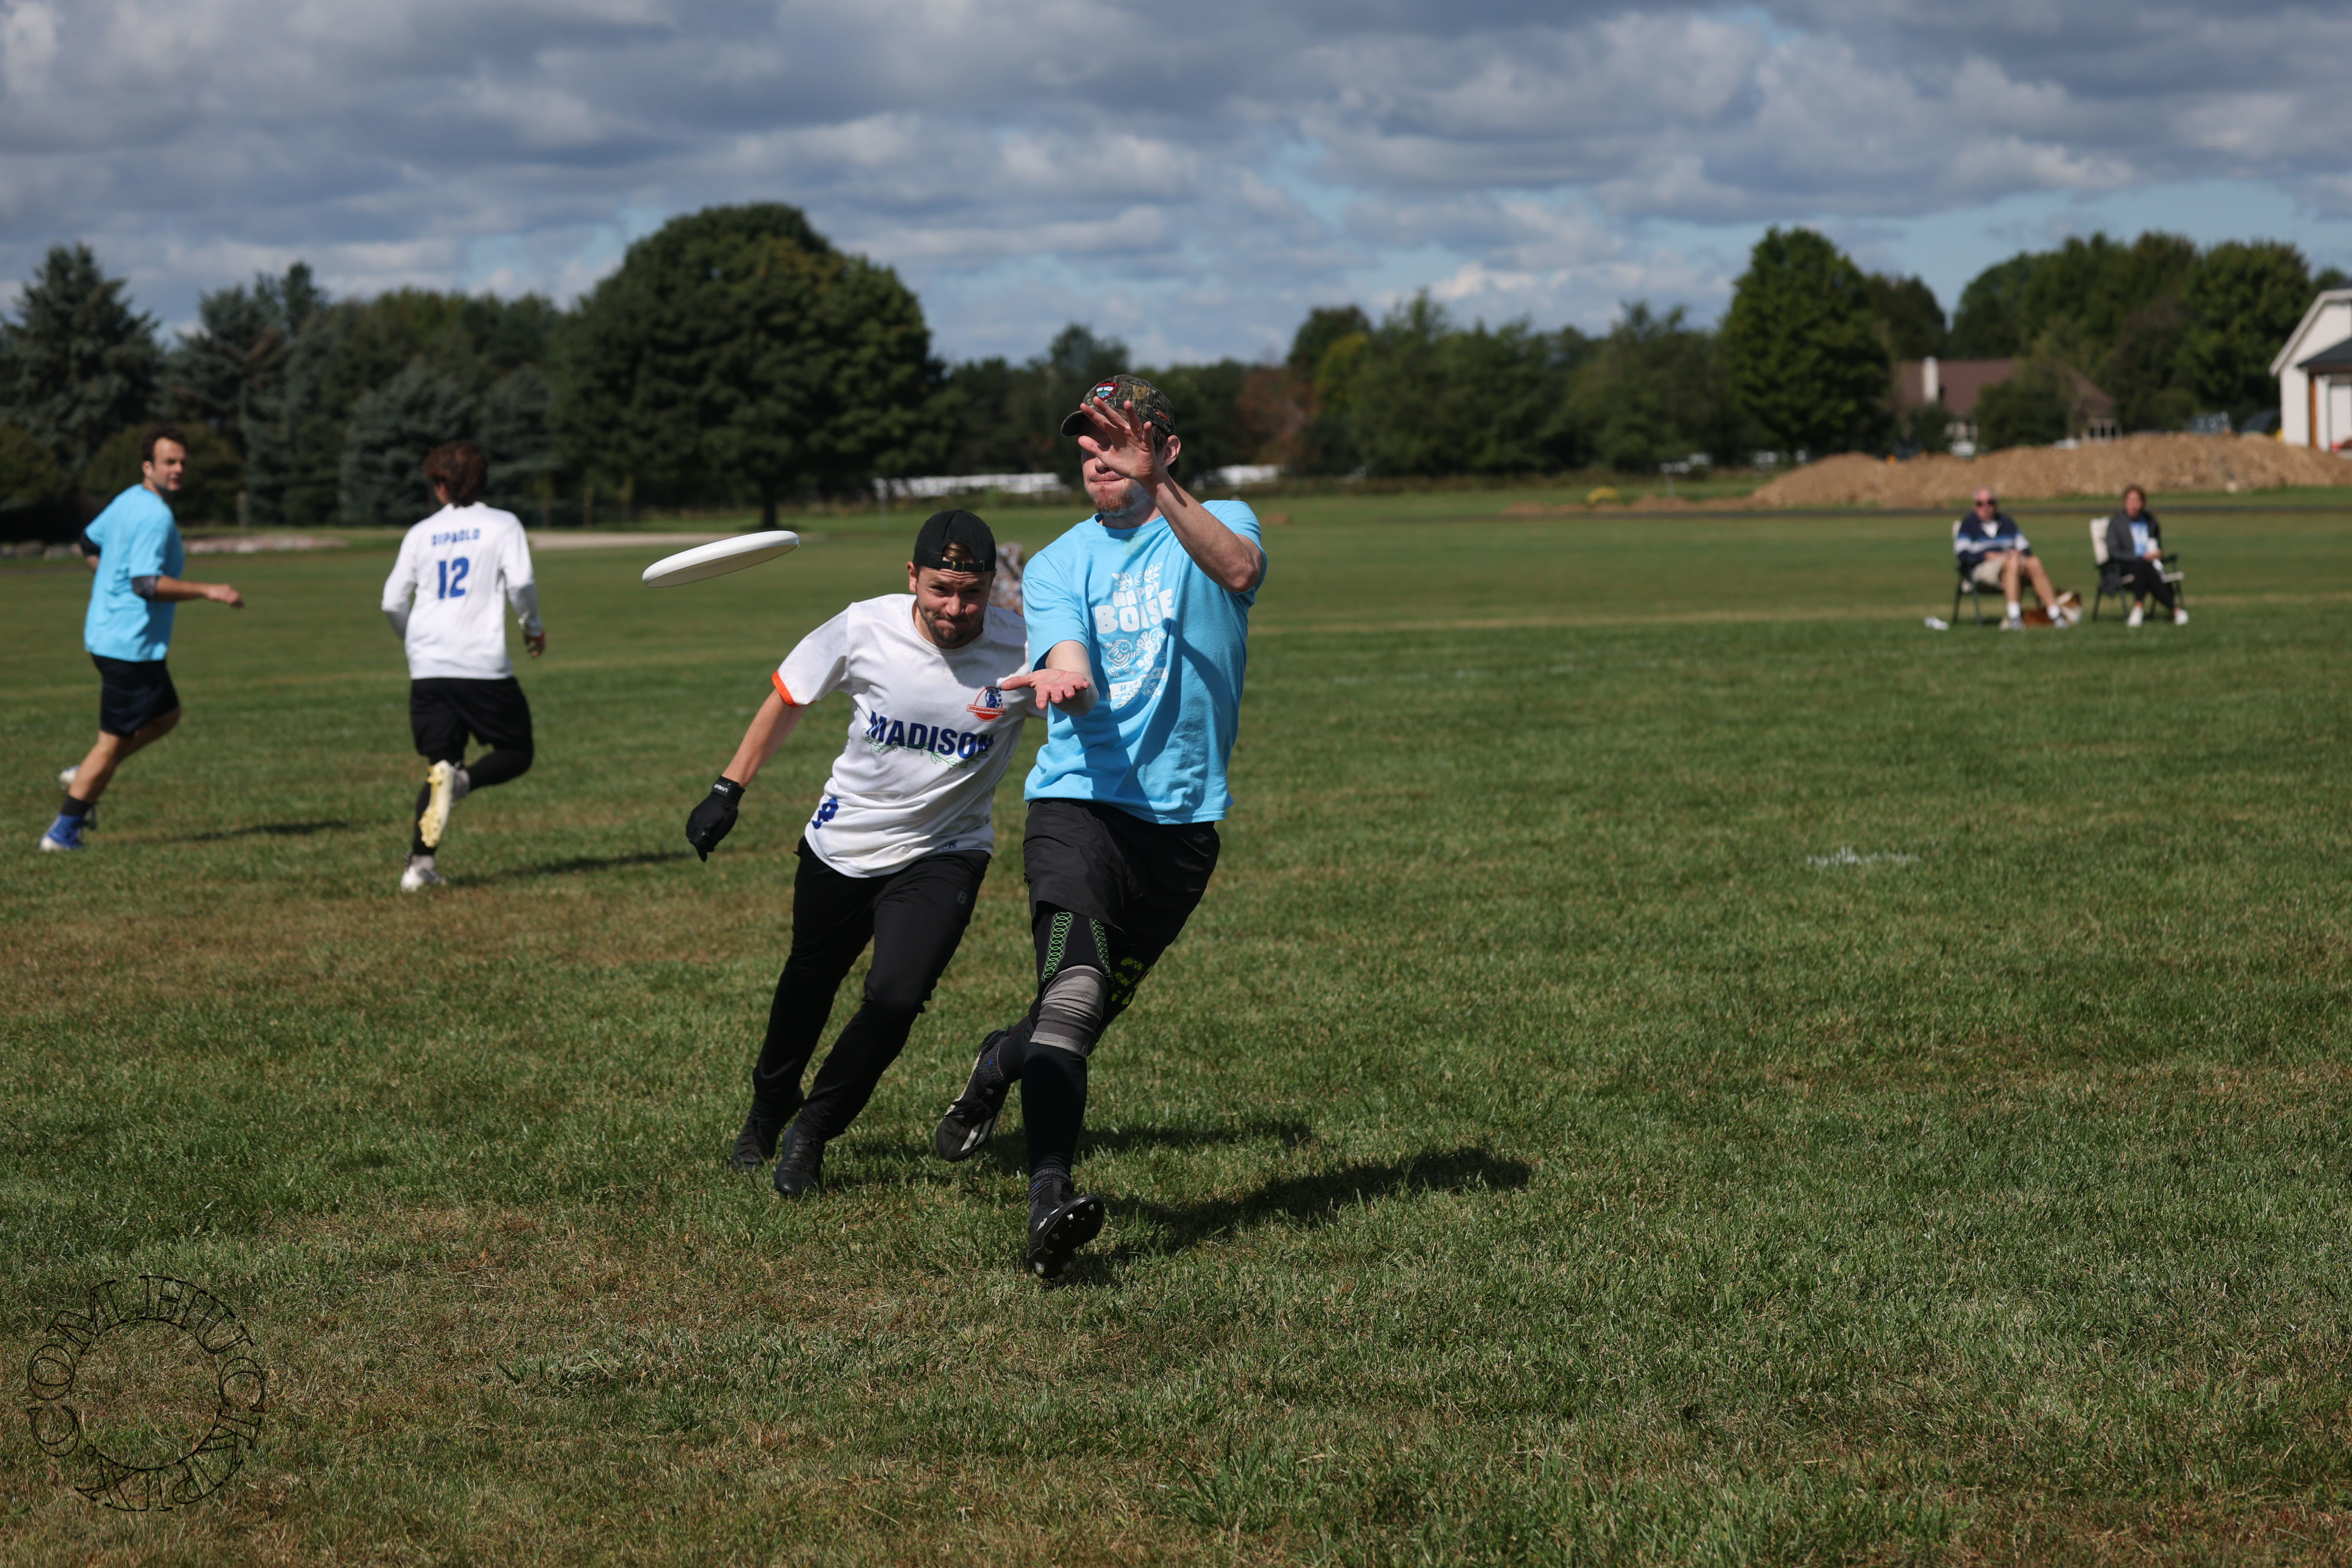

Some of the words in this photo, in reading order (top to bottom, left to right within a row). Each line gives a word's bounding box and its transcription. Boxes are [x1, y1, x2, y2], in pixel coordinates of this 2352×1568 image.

[432, 528, 480, 546] DIPAOLO
[438, 556, 469, 600] 12
[1095, 589, 1174, 634] BOISE
[866, 710, 994, 759] MADISON
